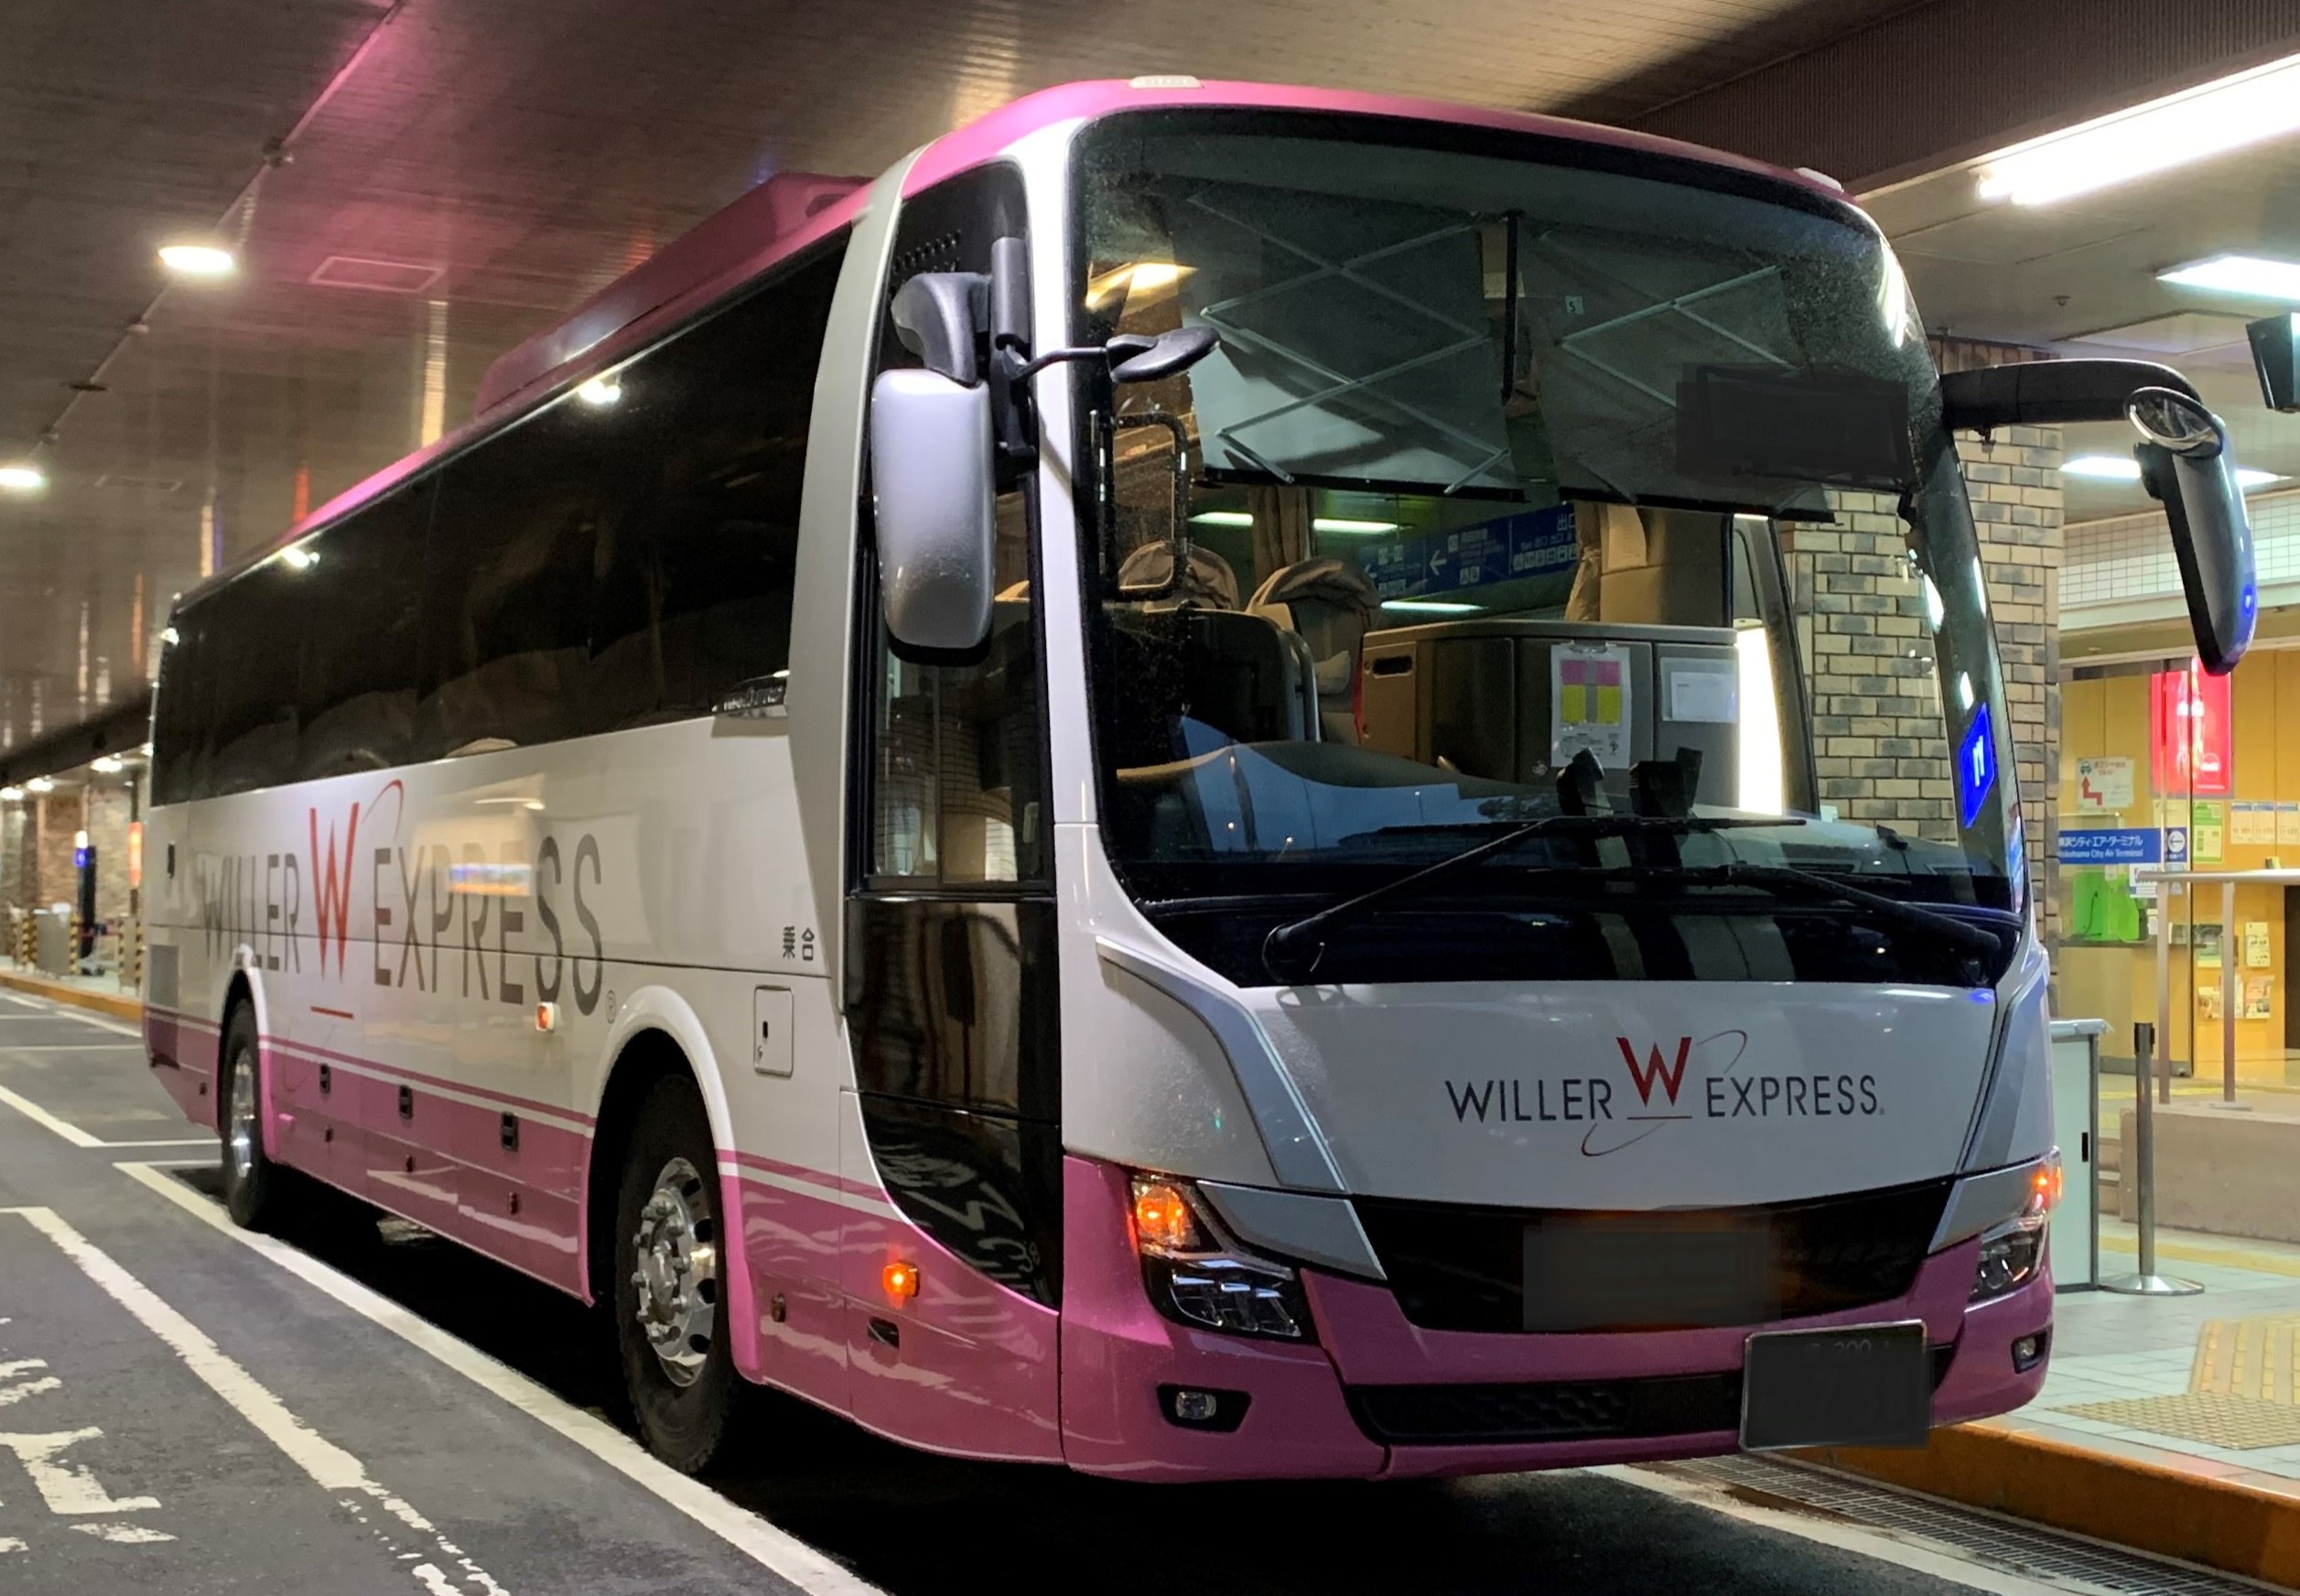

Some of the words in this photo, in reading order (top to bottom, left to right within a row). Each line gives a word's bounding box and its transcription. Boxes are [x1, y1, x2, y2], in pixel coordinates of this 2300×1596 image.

[2090, 849, 2104, 858] City
[2105, 849, 2115, 857] Air
[2116, 849, 2143, 857] Terminal
[200, 852, 301, 975] WILLER
[308, 802, 360, 985] W
[373, 834, 603, 1017] EXPRESS
[1444, 1078, 1614, 1123] WILLER
[1615, 1036, 1692, 1106] W
[1706, 1074, 1879, 1117] EXPRESS
